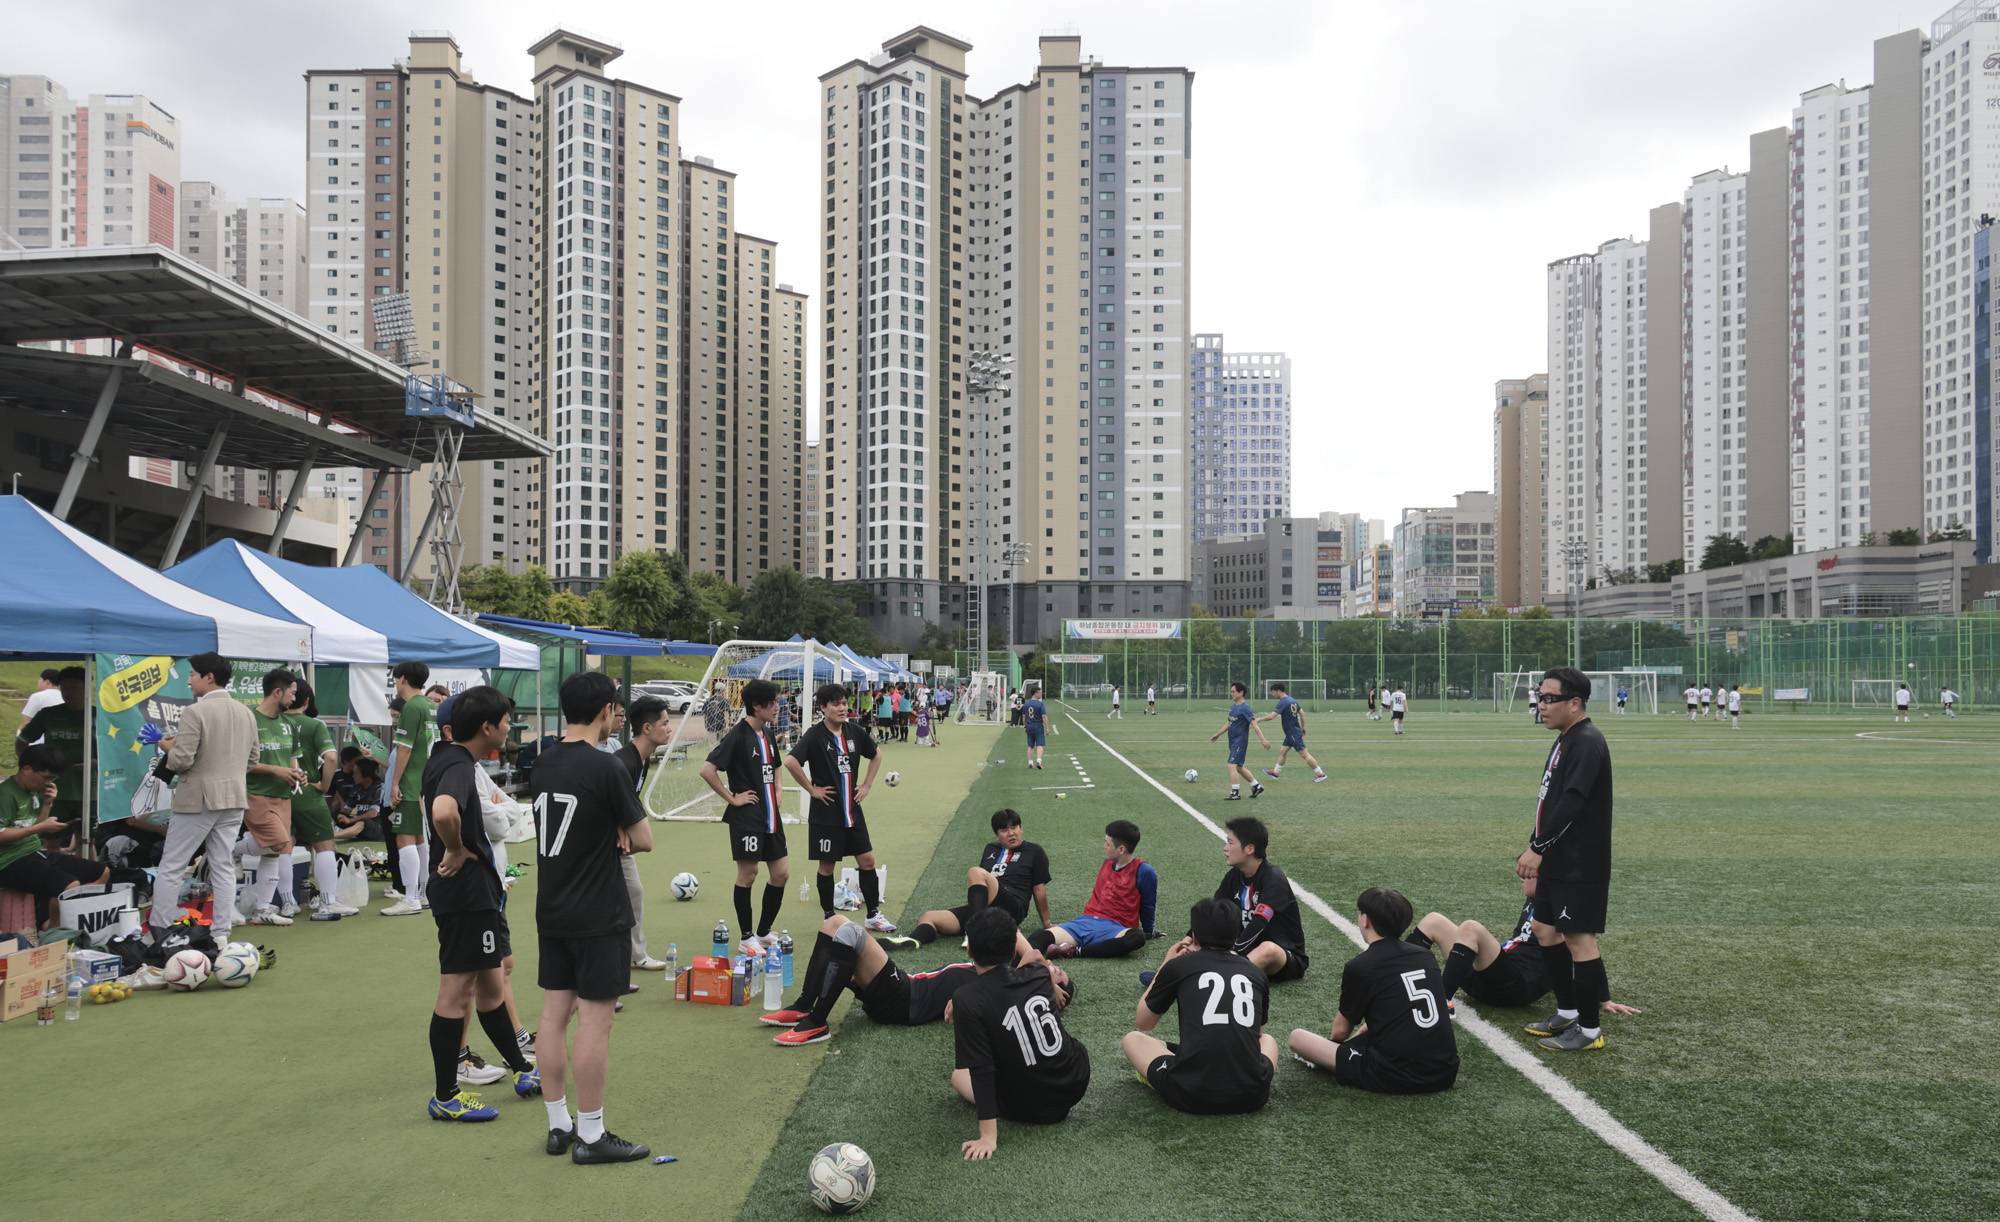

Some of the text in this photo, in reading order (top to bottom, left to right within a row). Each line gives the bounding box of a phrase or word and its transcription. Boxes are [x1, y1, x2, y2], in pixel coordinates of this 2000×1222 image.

[150, 128, 175, 151] HOBAN
[116, 664, 162, 702] 한국일보
[1394, 696, 1402, 704] 16
[1028, 706, 1035, 719] 8
[280, 723, 292, 735] 31
[837, 755, 850, 765] FC
[762, 764, 774, 775] FC
[534, 792, 578, 857] 17
[742, 835, 758, 852] 18
[819, 839, 831, 853] 10
[992, 863, 1008, 873] FC
[1257, 904, 1264, 913] C
[482, 930, 496, 954] 9
[1198, 971, 1256, 1028] 28
[1400, 968, 1439, 1029] 5
[1002, 995, 1063, 1067] 16
